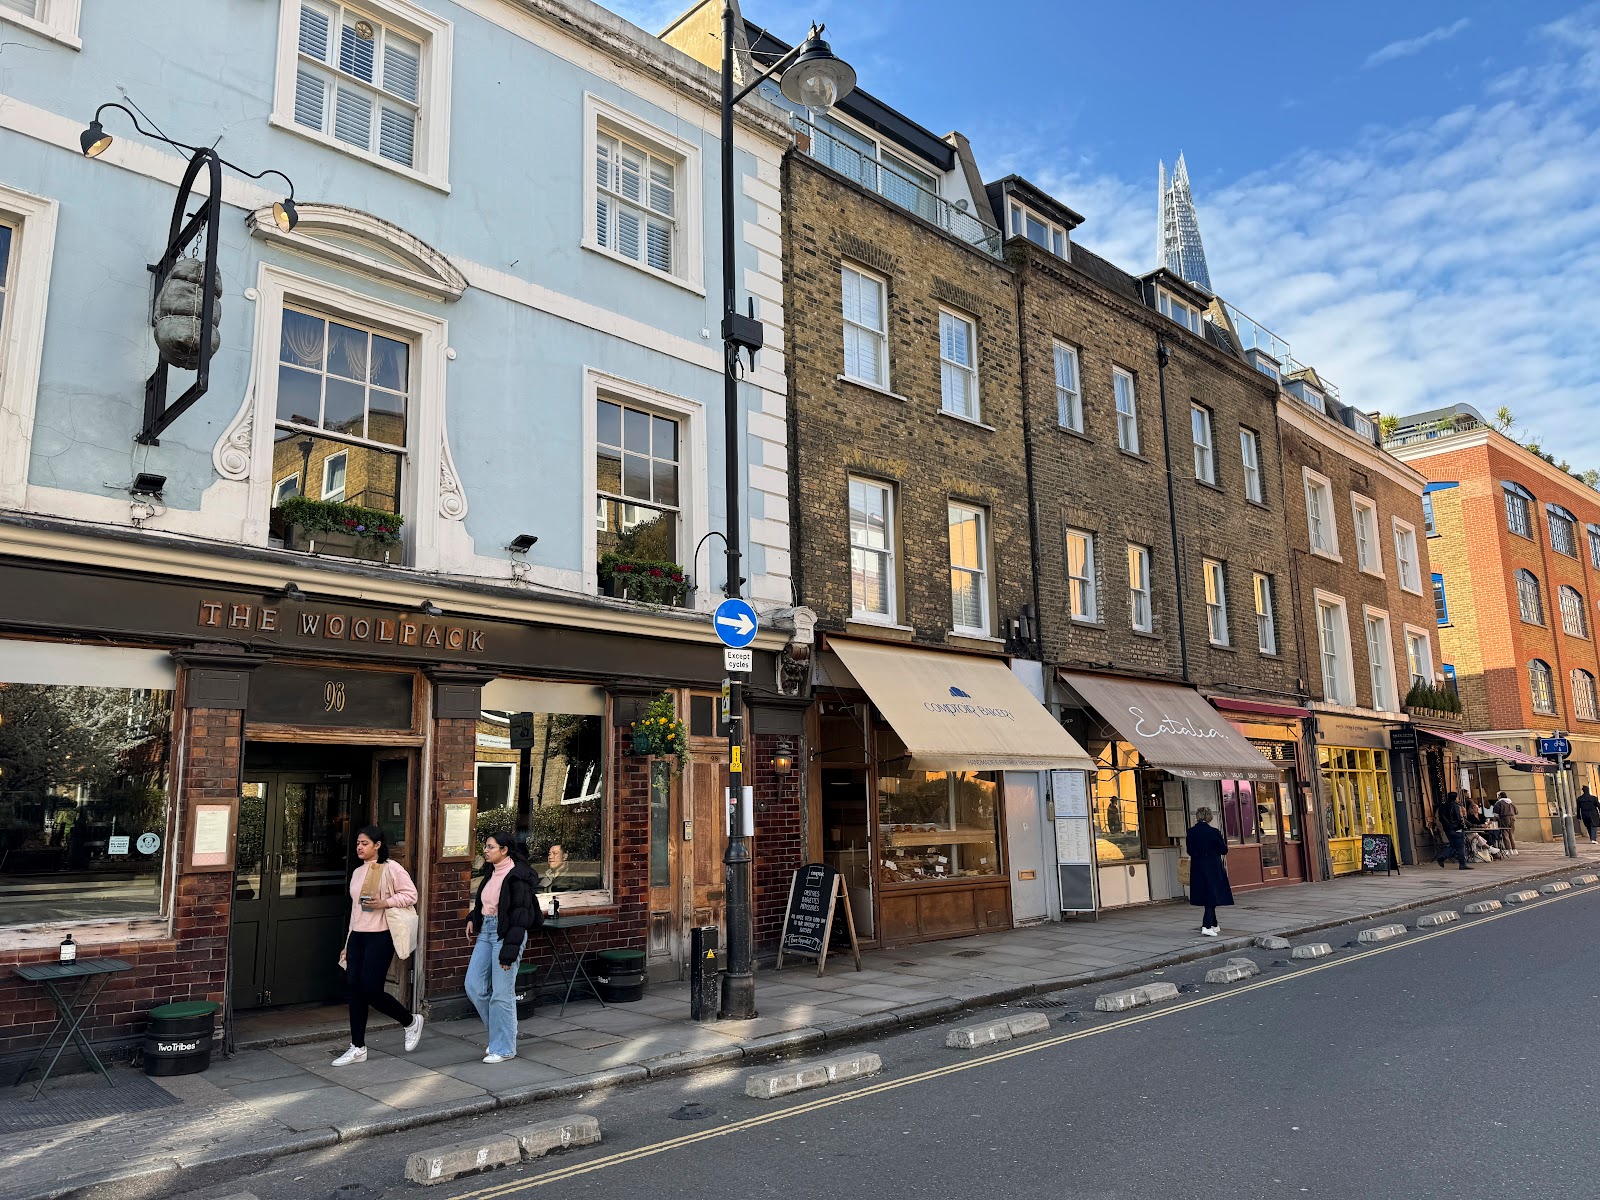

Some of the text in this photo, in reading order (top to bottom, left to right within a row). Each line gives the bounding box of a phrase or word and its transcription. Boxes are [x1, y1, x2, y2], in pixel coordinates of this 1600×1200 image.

[203, 603, 485, 650] THE WOOLPACK
[727, 651, 750, 660] Except
[728, 660, 749, 669] cycles
[324, 681, 345, 712] 98
[924, 702, 1015, 721] COMPTOIR BAKERY
